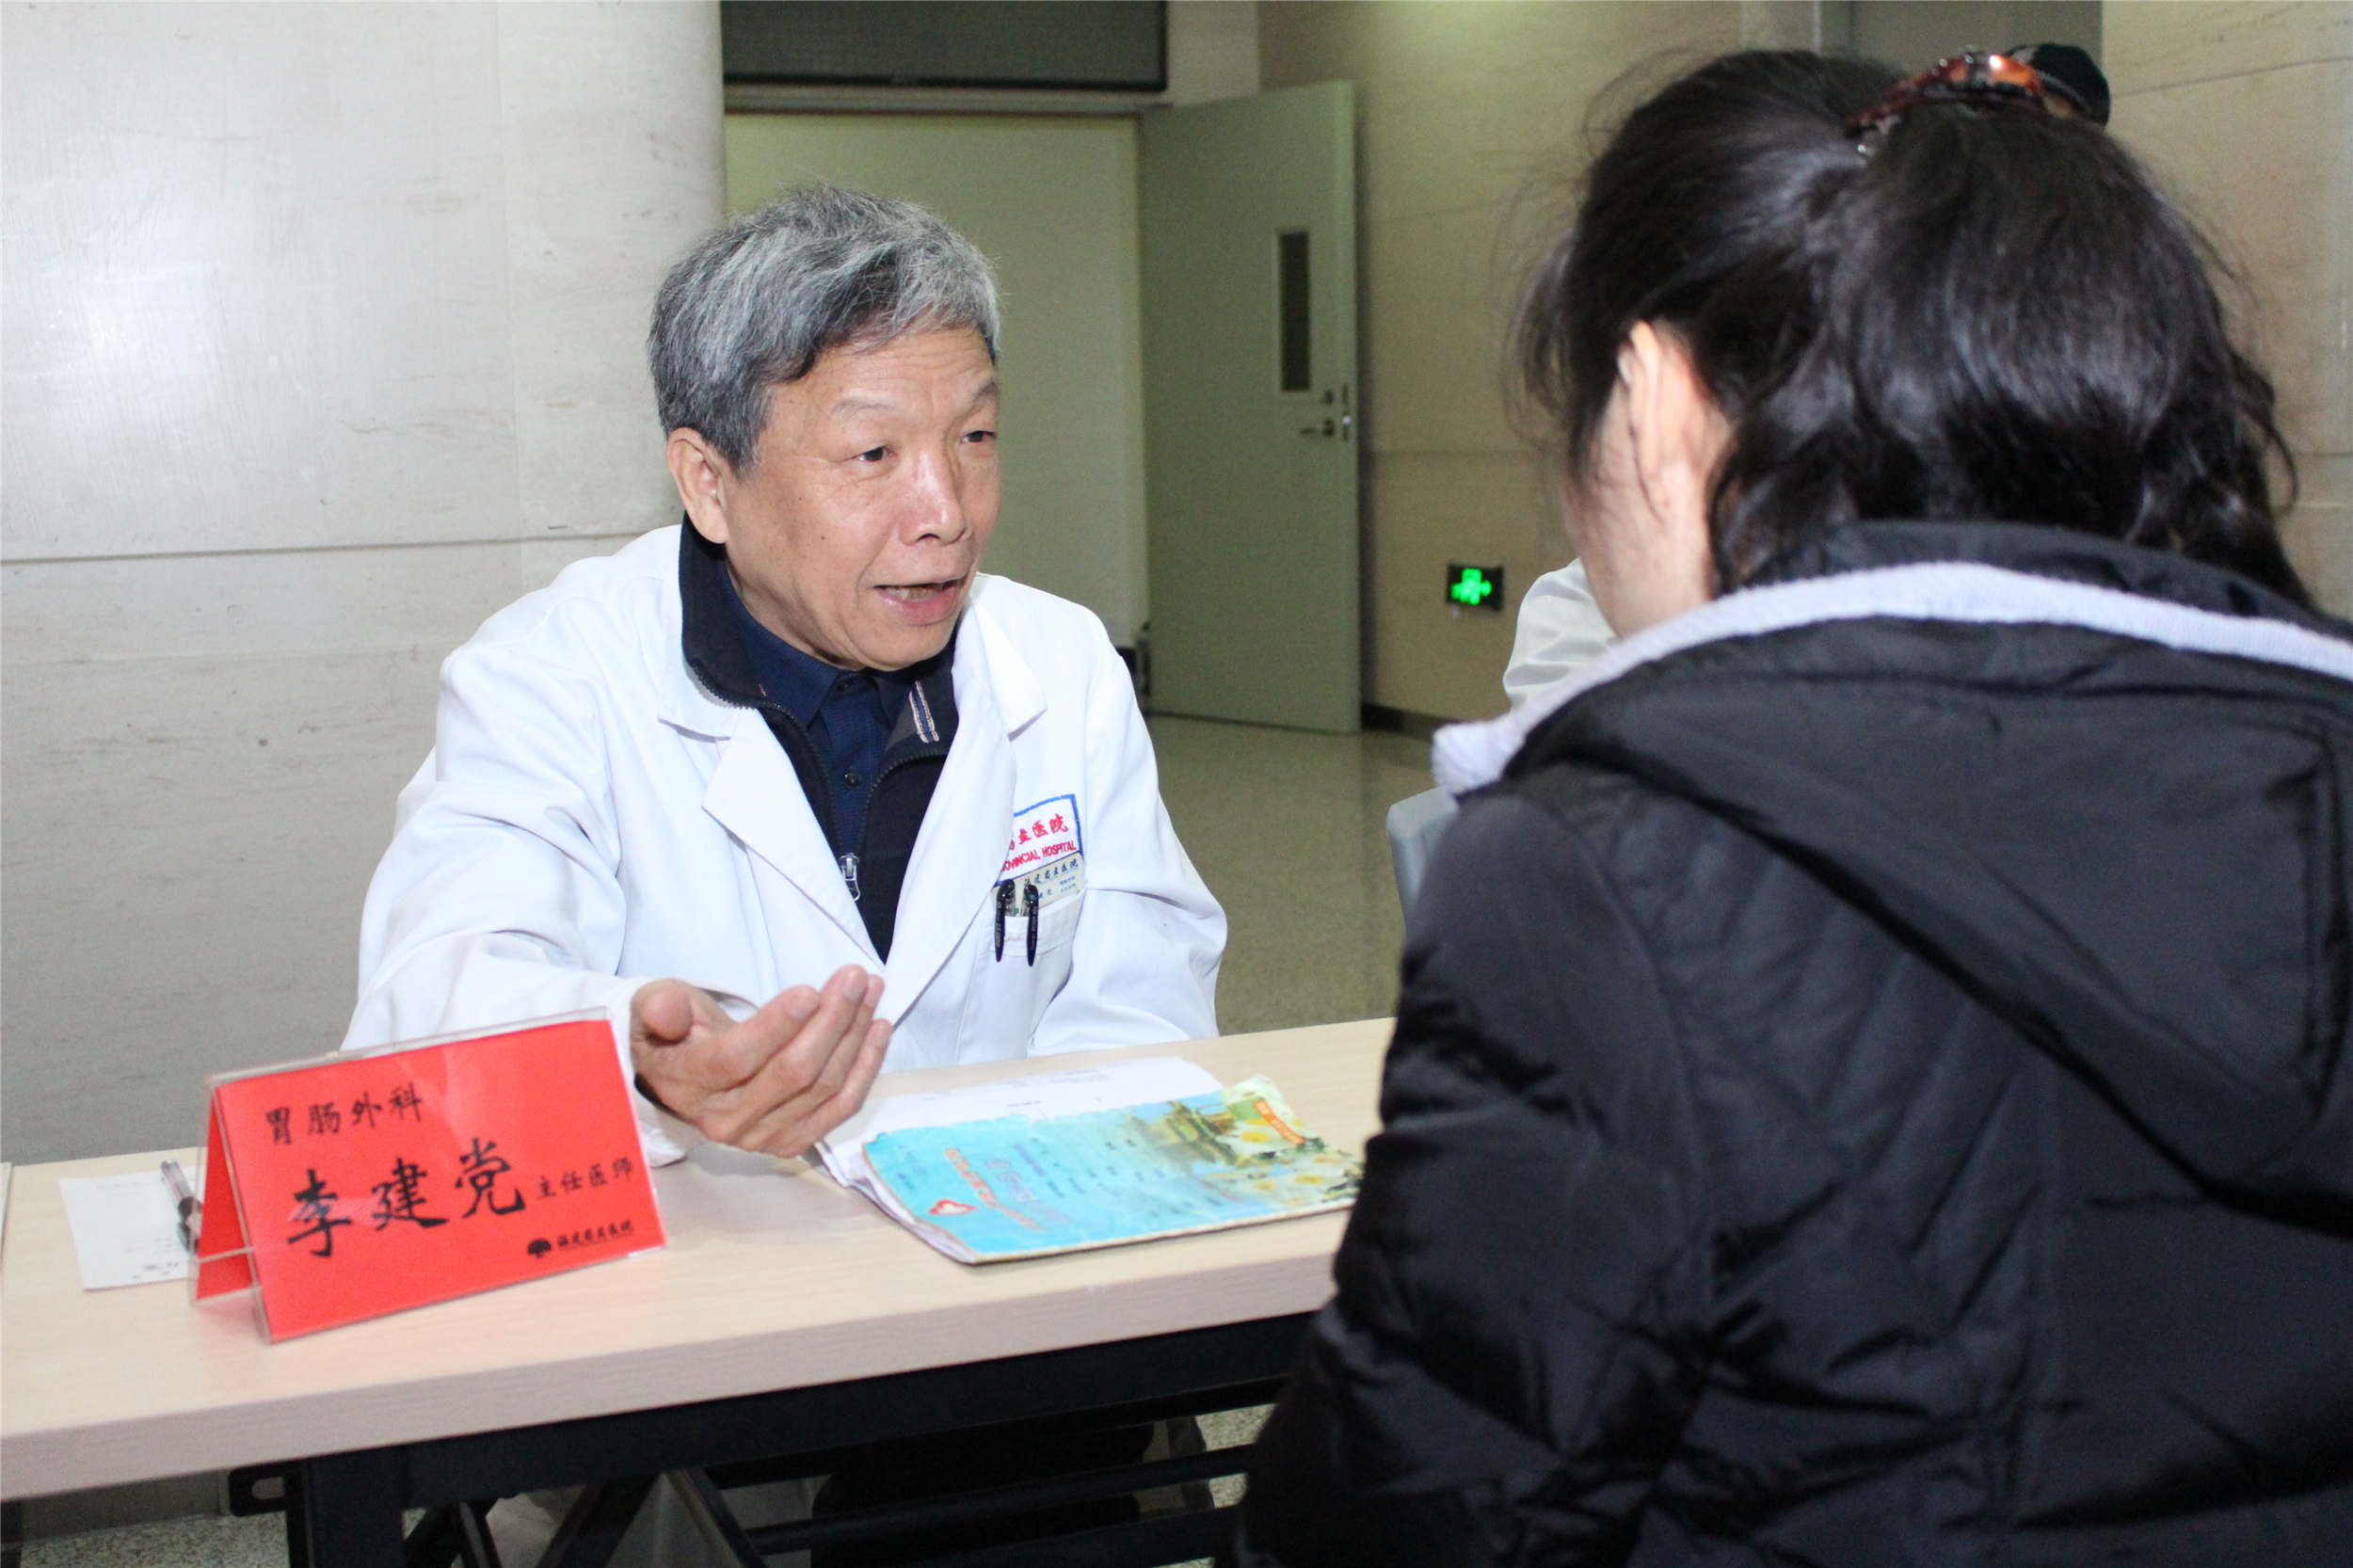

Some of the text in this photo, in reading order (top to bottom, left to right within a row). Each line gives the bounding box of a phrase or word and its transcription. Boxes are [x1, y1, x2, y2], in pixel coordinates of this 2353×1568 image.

[1041, 840, 1078, 858] HOSPITAL
[264, 1081, 424, 1146] 胃肠外科
[287, 1137, 634, 1257] 李建党 主任医师
